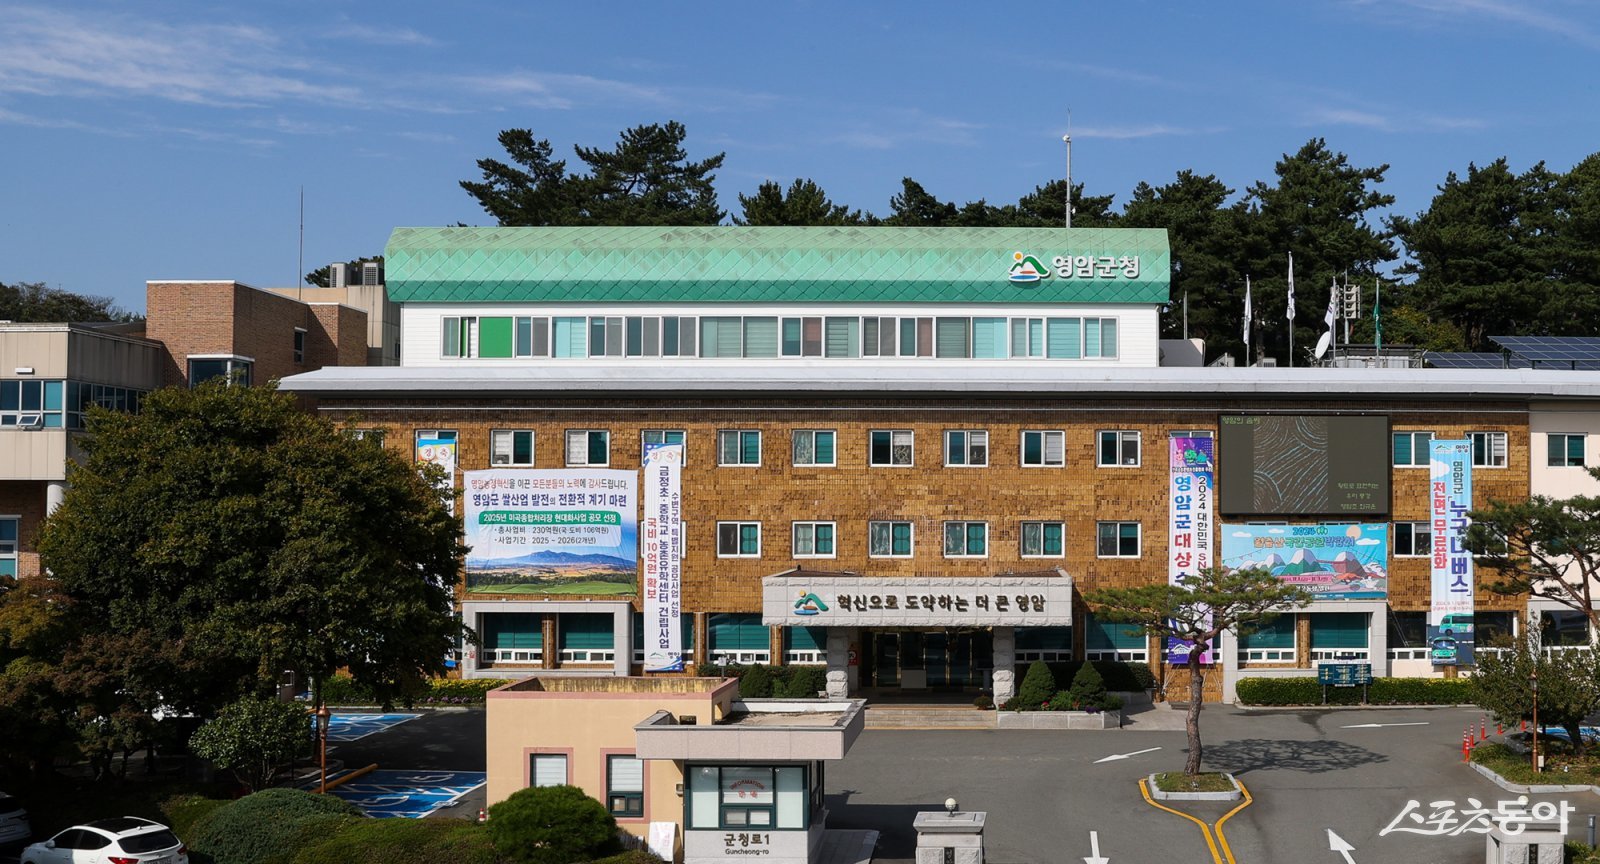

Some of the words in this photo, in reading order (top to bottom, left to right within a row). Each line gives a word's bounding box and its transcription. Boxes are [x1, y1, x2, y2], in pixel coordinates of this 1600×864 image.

[1053, 255, 1140, 278] 영암군청
[517, 479, 530, 489] 이끈
[532, 479, 565, 489] 모든분들의
[567, 479, 586, 489] 노력에
[588, 479, 629, 490] 감사드립니다.
[1453, 461, 1463, 494] 영암군
[472, 493, 499, 506] 영암군
[502, 493, 528, 506] 쌀산업
[531, 493, 556, 506] 발전의
[558, 493, 586, 506] 전환적
[588, 493, 606, 506] 계기
[609, 494, 627, 507] 마련
[1198, 476, 1207, 510] 2024
[1433, 482, 1446, 515] 전면
[483, 513, 507, 523] 2025년
[508, 513, 553, 523] 미곡종합처리장
[554, 513, 587, 523] 현대화사업
[588, 513, 602, 522] 공모
[603, 514, 617, 523] 선정
[647, 517, 657, 538] 국비
[531, 536, 550, 544] 2025
[557, 536, 597, 545] 2026(2개년)
[1197, 512, 1208, 550] 대한민국
[1433, 519, 1447, 569] 무료화
[646, 543, 657, 574] 10억원
[659, 540, 669, 603] 농촌유학센터
[671, 565, 679, 598] 공모사업
[647, 577, 657, 599] 확보
[671, 601, 679, 617] 선정
[837, 594, 899, 612] 혁신으로
[905, 594, 969, 612] 도약하는
[975, 594, 989, 612] 더
[995, 595, 1010, 612] 큰
[1015, 594, 1046, 612] 영암
[659, 607, 669, 649] 건립사업
[724, 833, 763, 847] 군청로
[764, 834, 770, 845] 1
[725, 848, 770, 856] Guncheong-ro
